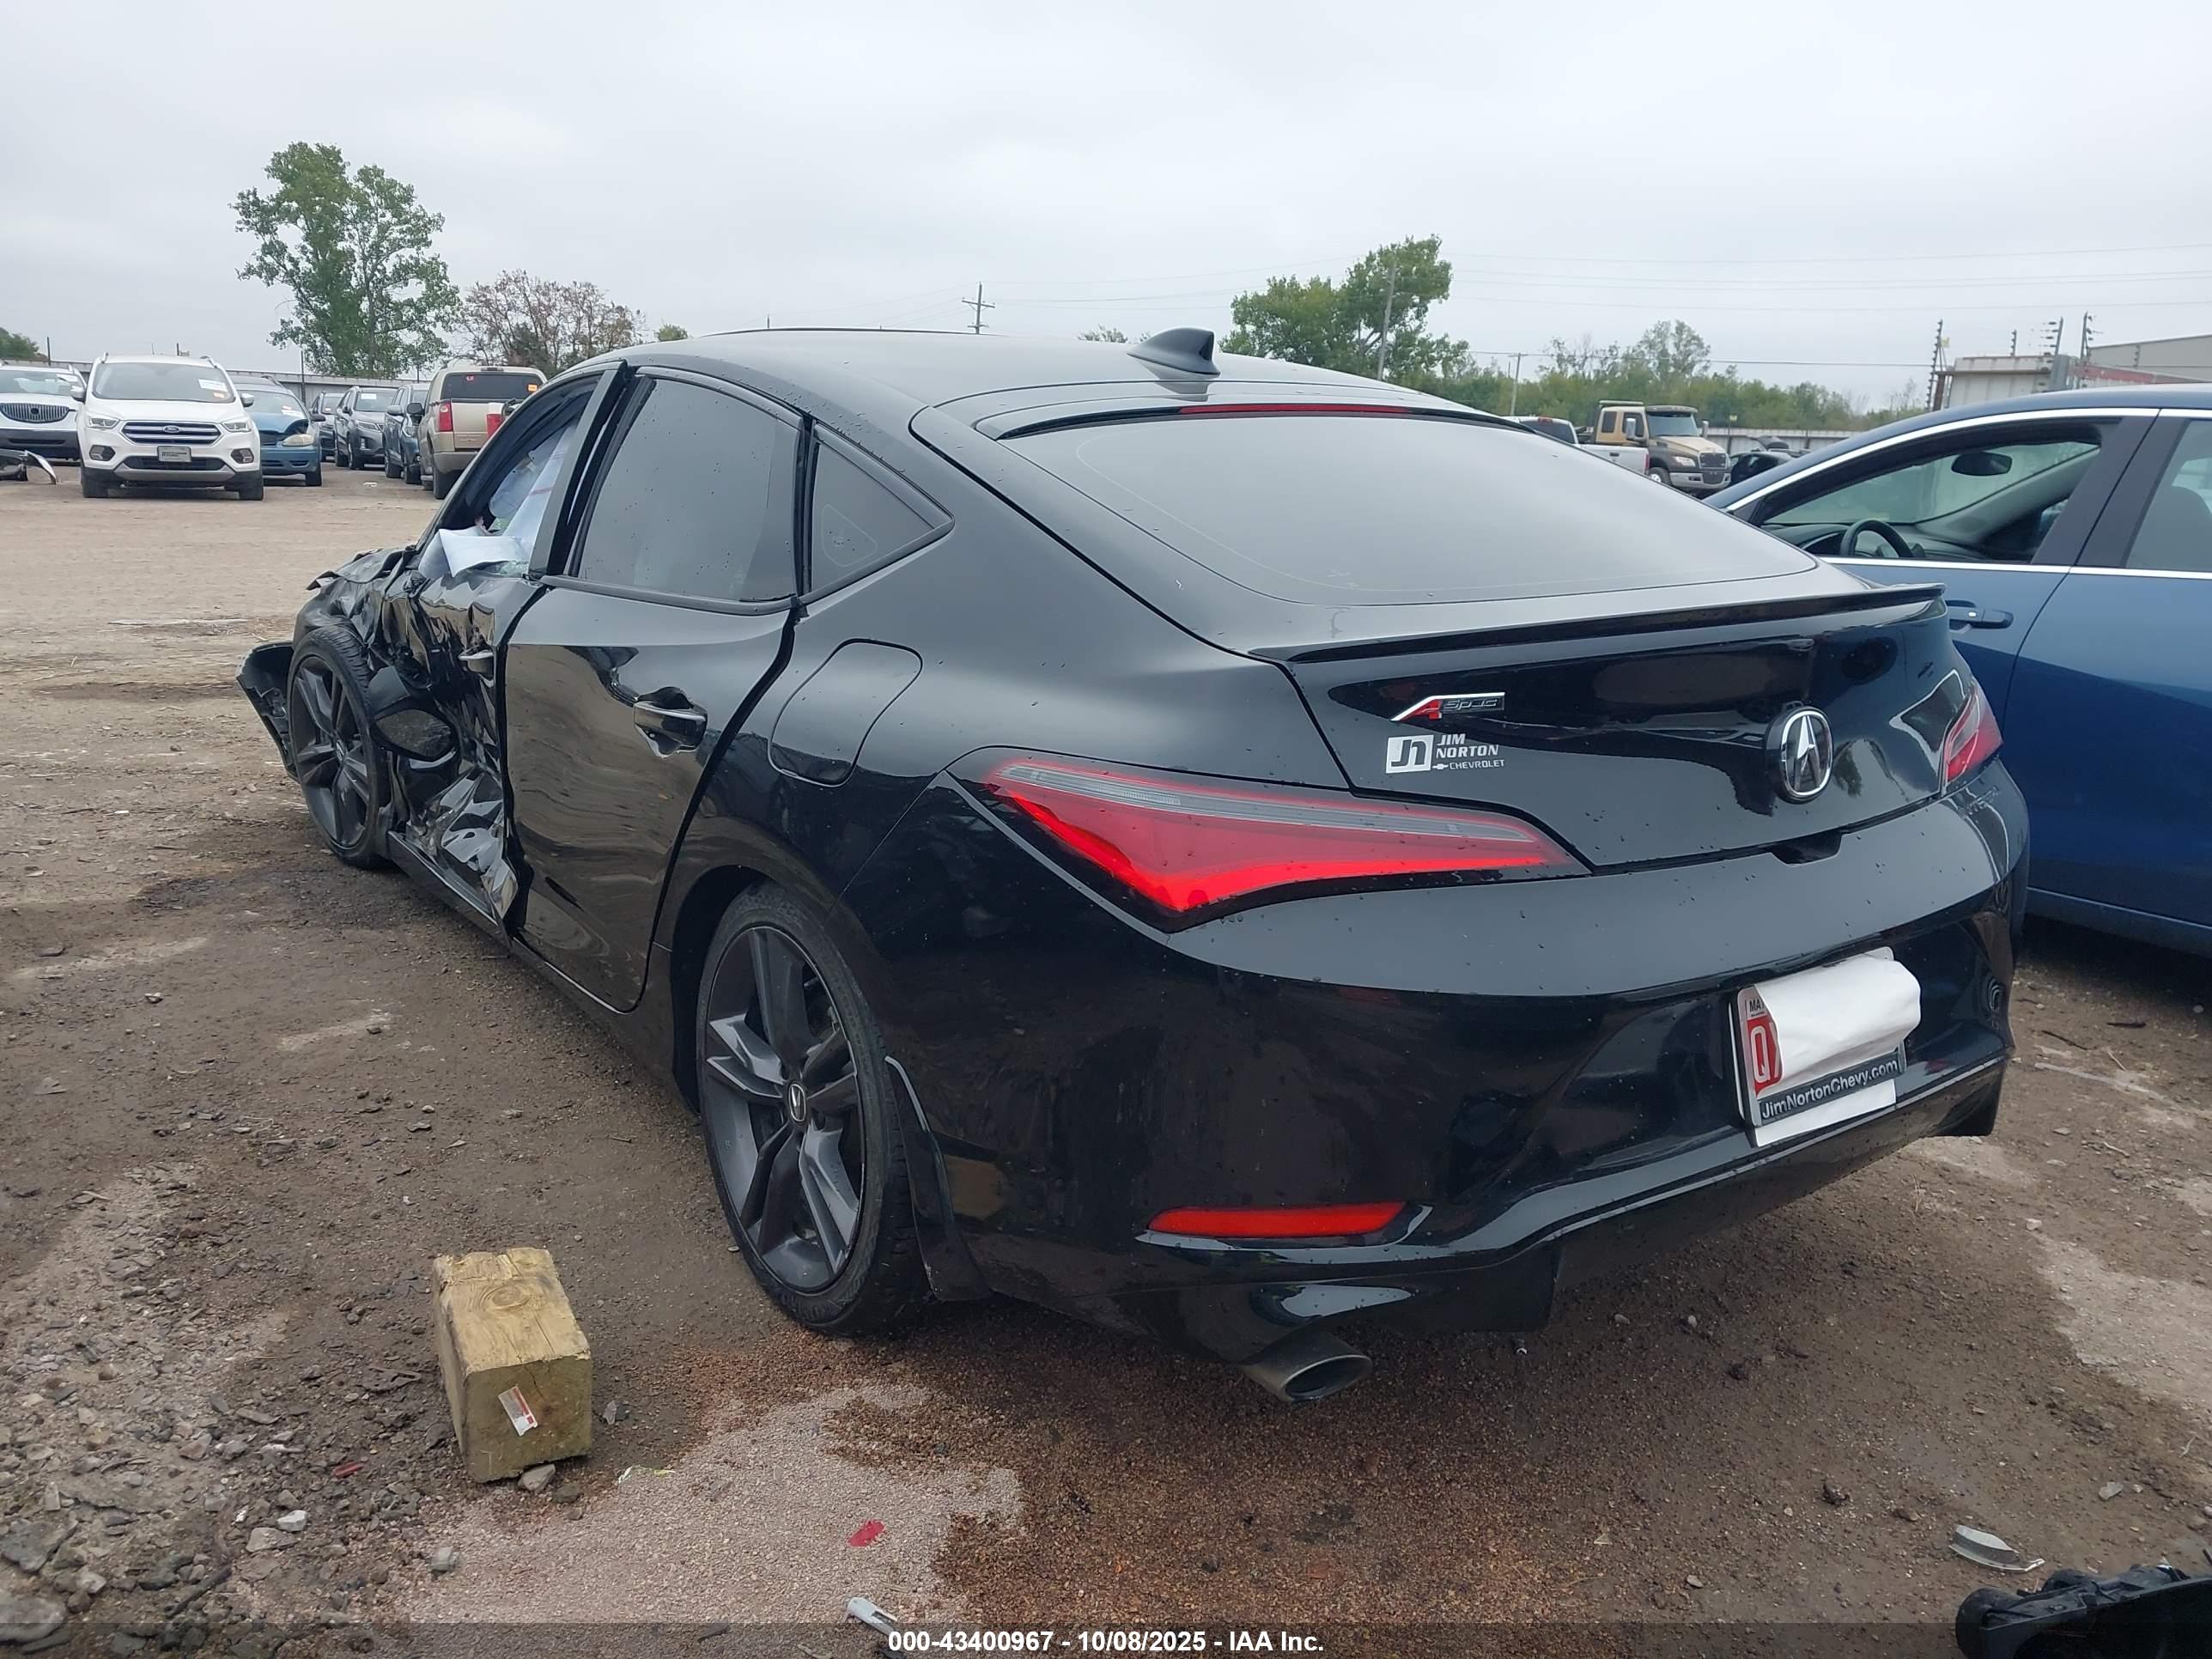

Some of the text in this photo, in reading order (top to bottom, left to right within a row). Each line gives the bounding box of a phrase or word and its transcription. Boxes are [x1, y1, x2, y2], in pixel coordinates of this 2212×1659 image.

[1437, 733, 1467, 746] JIM
[1436, 744, 1499, 759] NORTON
[1449, 759, 1505, 770] CHEVROLET
[1762, 1058, 1899, 1119] JimNortonChevy.com
